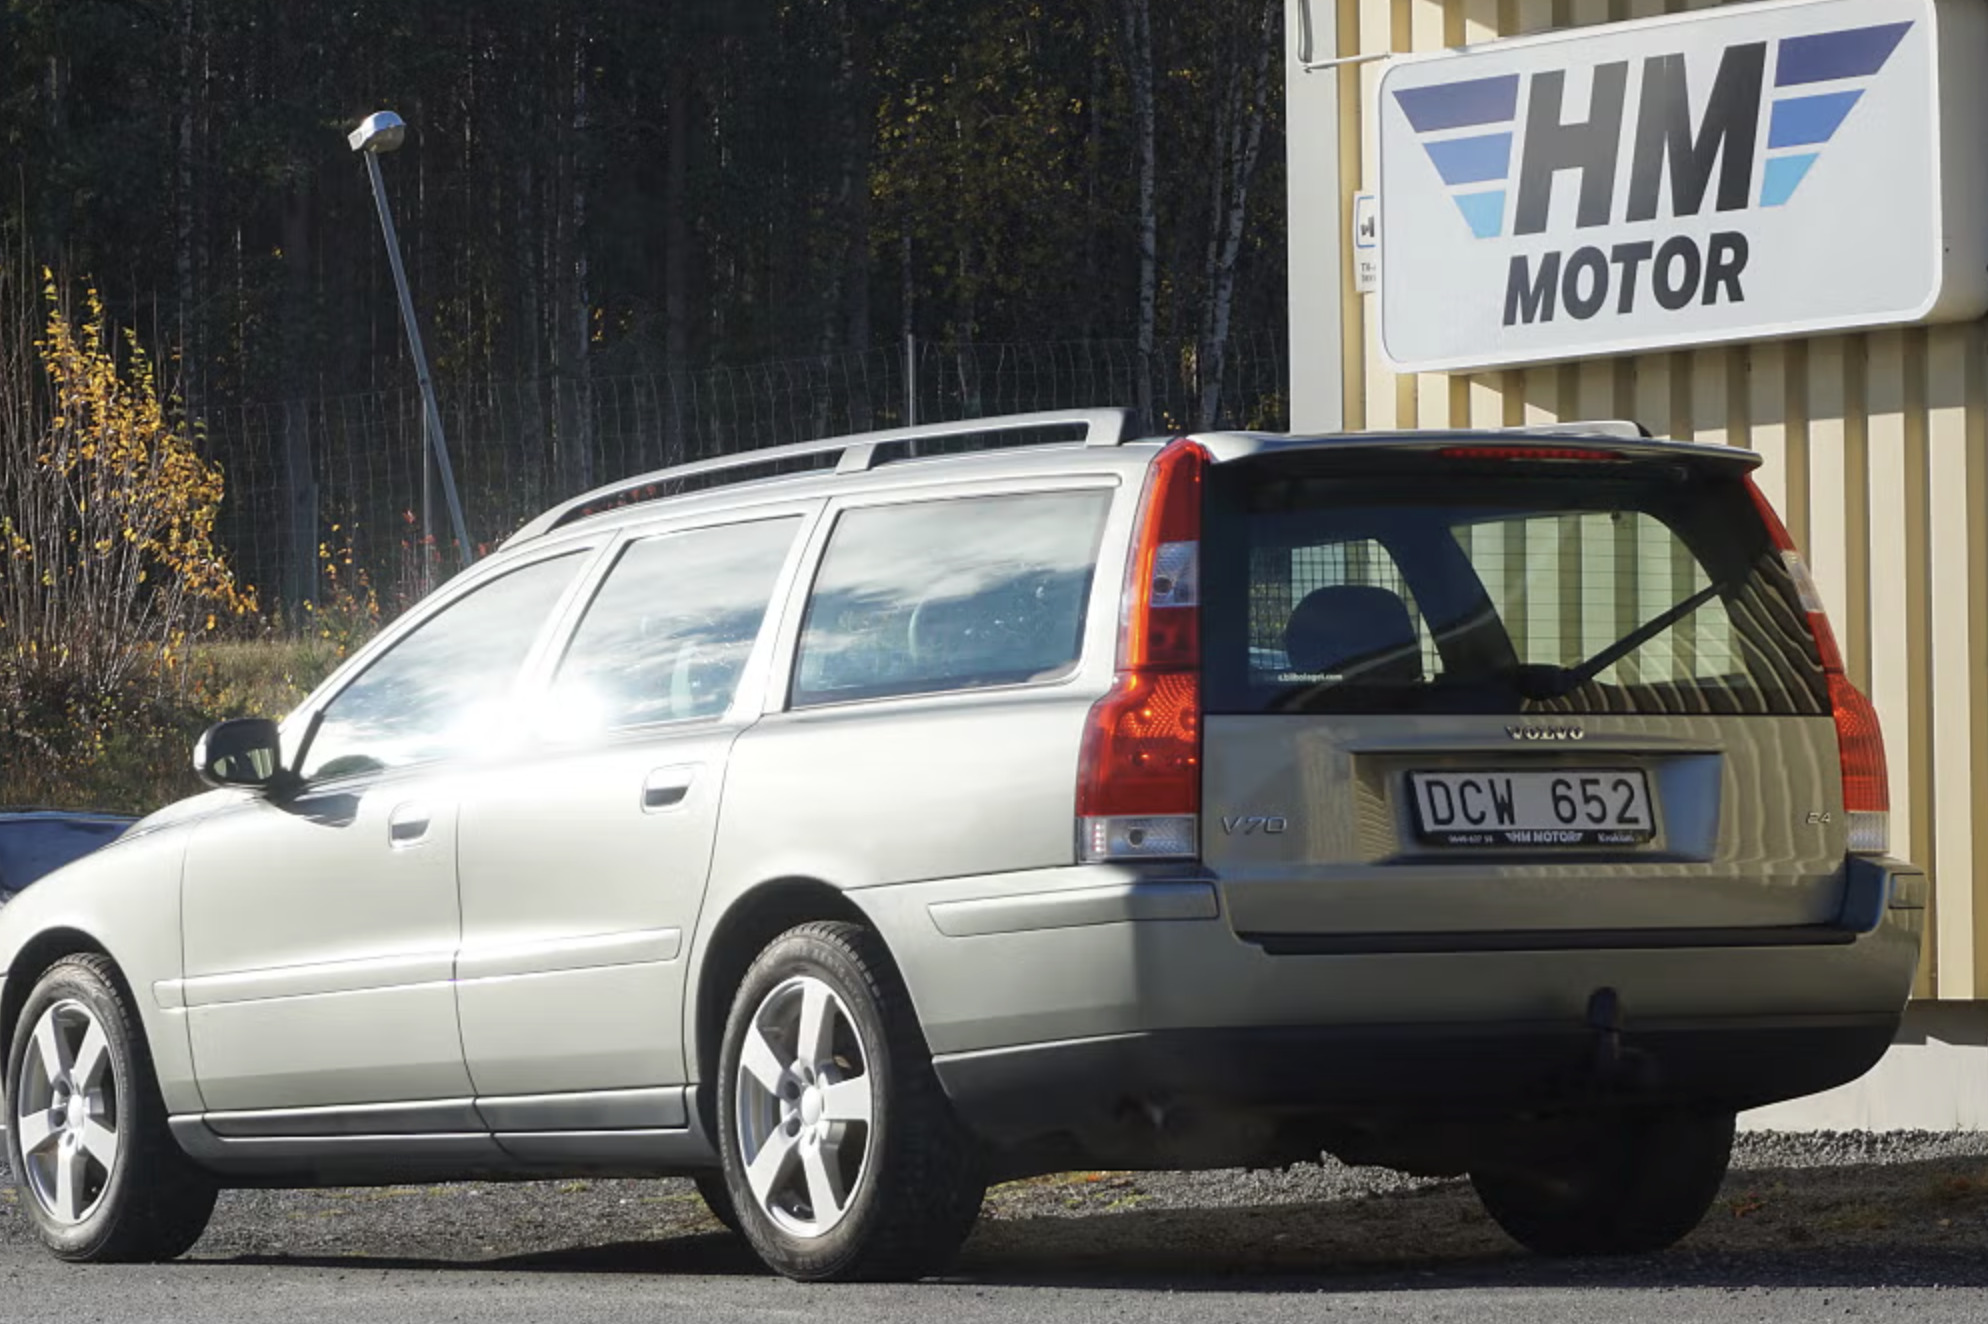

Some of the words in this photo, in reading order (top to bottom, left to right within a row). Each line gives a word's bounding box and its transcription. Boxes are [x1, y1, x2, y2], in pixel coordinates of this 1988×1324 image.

[1513, 40, 1767, 236] HM
[1503, 230, 1749, 326] MOTOR
[1504, 726, 1584, 740] VOLVO
[1424, 778, 1516, 826] DCW
[1550, 778, 1640, 825] 652
[1221, 816, 1287, 835] V70
[1533, 831, 1574, 843] MOTOR
